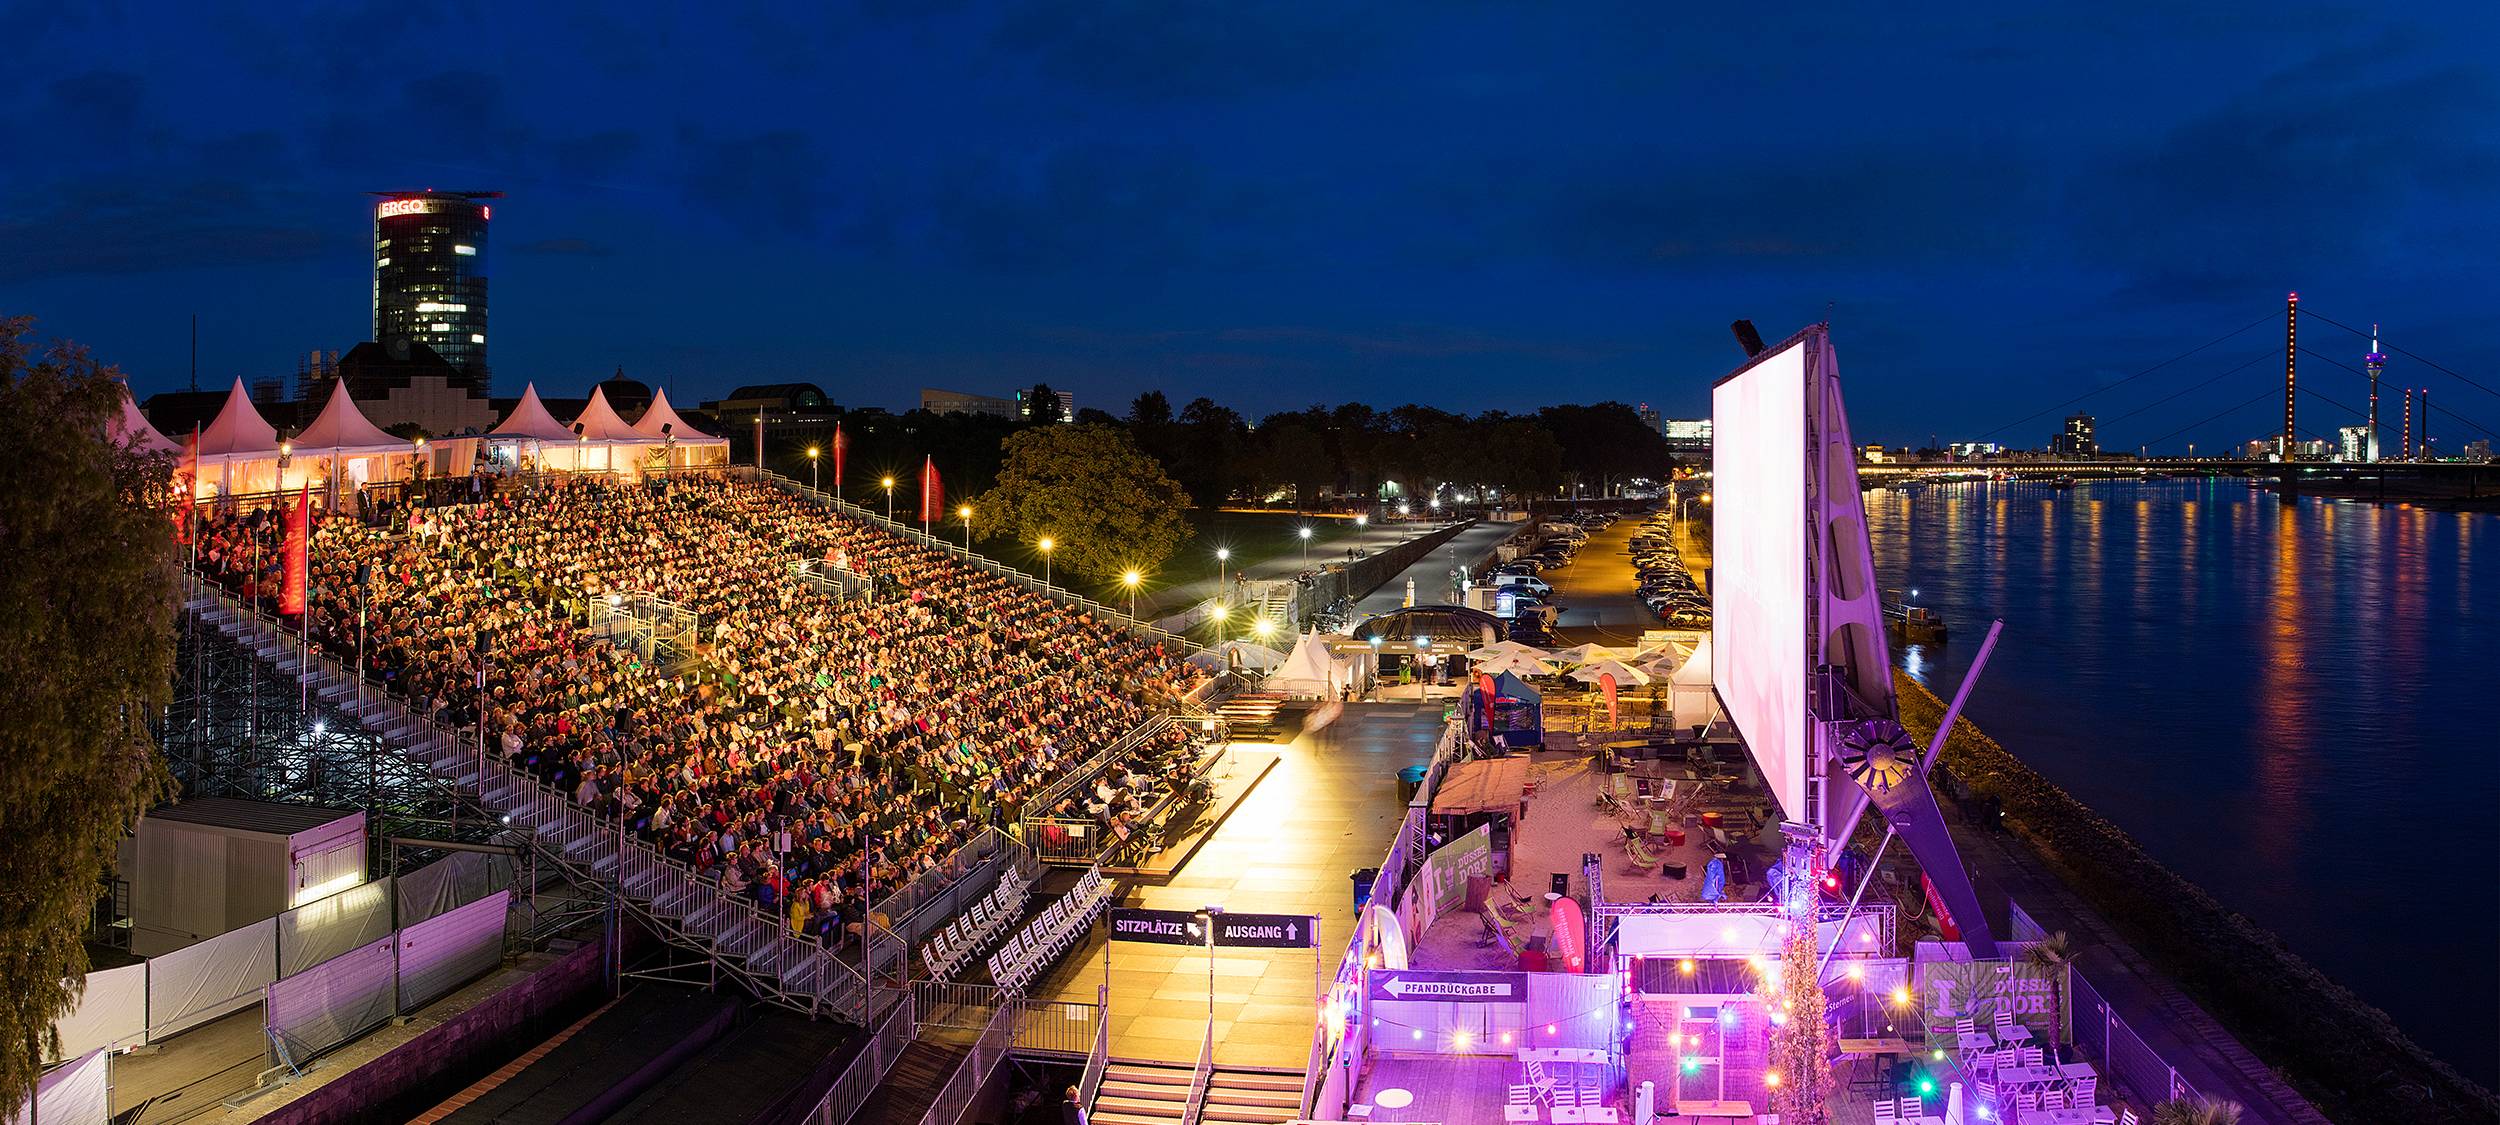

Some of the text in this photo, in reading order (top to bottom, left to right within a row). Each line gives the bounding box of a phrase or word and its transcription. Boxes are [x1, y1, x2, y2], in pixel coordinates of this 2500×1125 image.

[382, 199, 424, 213] ERGO
[1458, 845, 1487, 868] DÜSSEL
[1459, 856, 1488, 884] DORF
[1116, 919, 1183, 936] SITZPLÄTZE
[1224, 925, 1282, 938] AUSGANG
[1405, 983, 1496, 994] PFANDRÜCKGABE
[1994, 995, 2063, 1015] DOR
